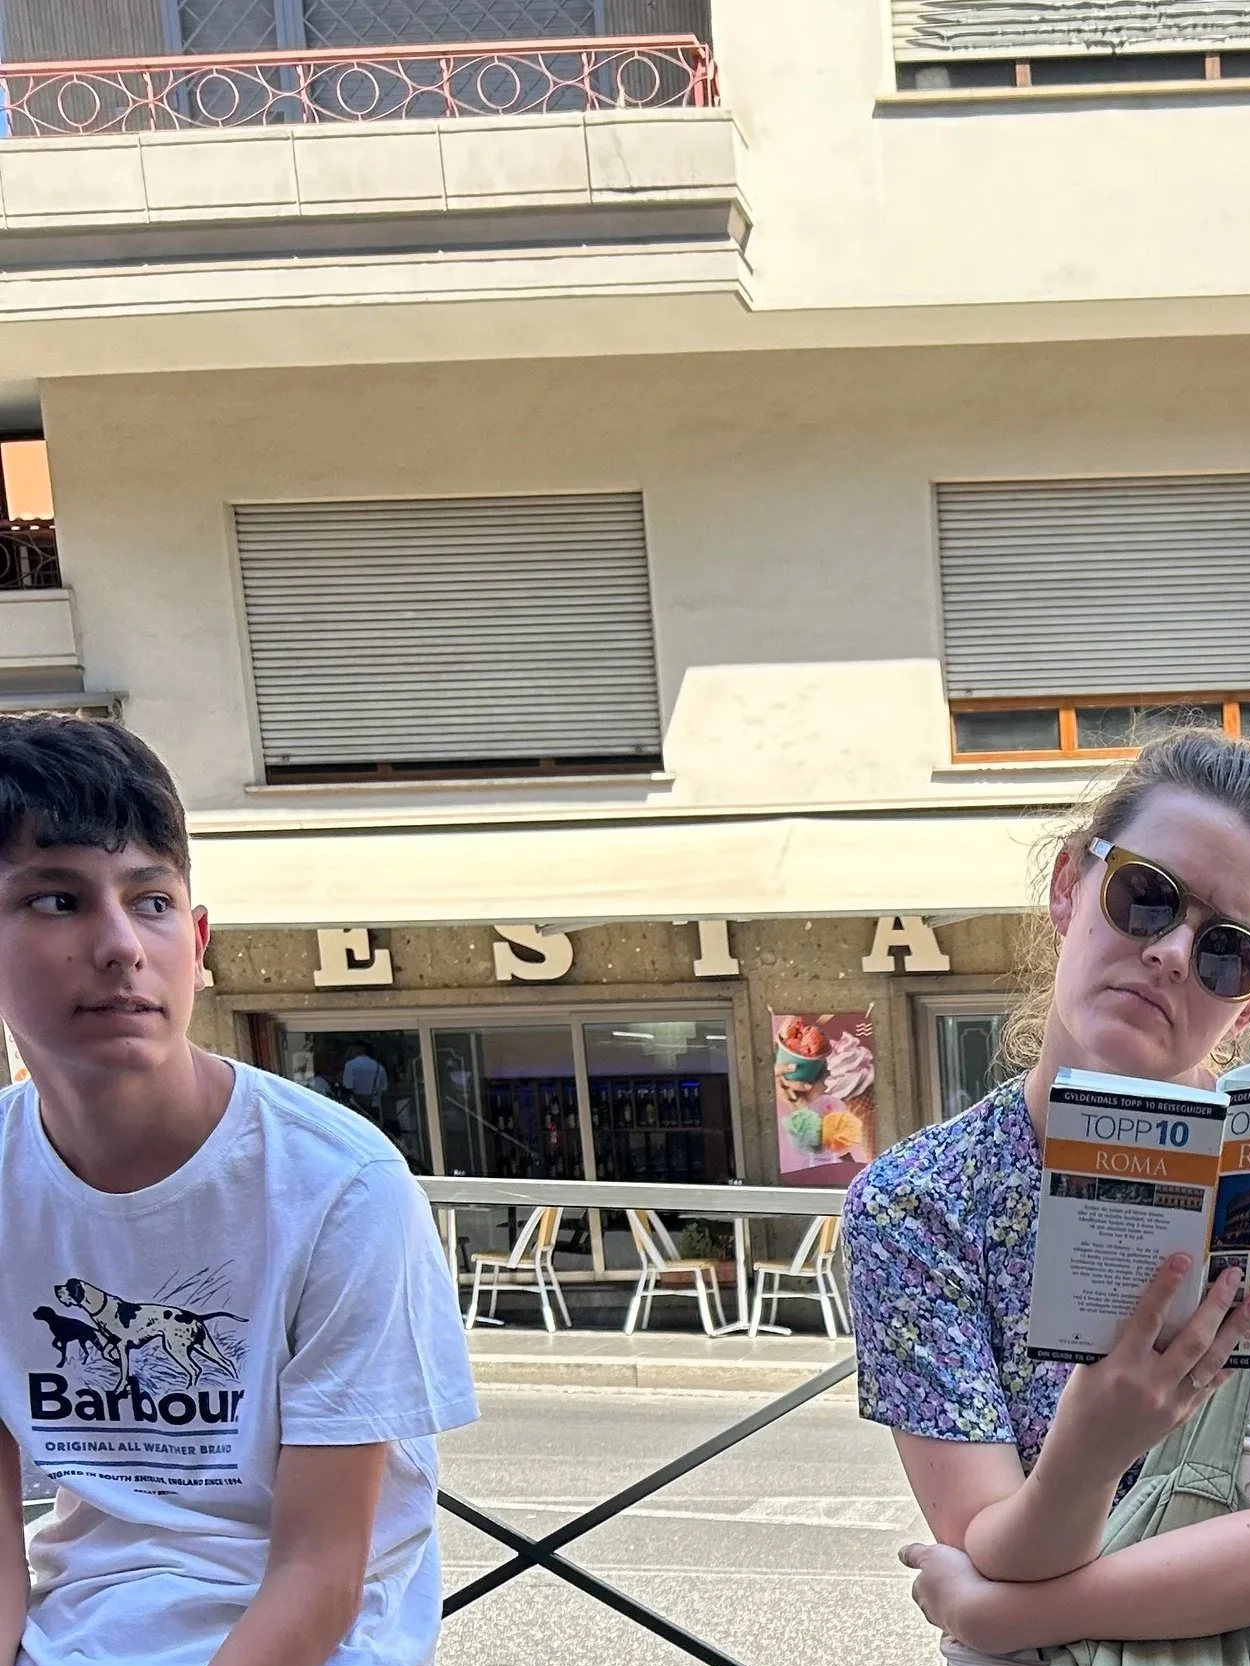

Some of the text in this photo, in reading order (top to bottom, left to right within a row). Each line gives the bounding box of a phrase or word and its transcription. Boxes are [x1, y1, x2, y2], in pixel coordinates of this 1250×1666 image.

[1064, 1092, 1118, 1106] GYLDENDALS
[1121, 1098, 1143, 1108] TOPP
[1096, 1151, 1167, 1177] ROMA
[28, 1372, 245, 1425] Barbour
[45, 1441, 114, 1452] ORIGINAL
[118, 1441, 141, 1452] ALL
[143, 1442, 197, 1456] WEATHER
[99, 1473, 132, 1482] SOUTH
[204, 1478, 223, 1486] SINCE
